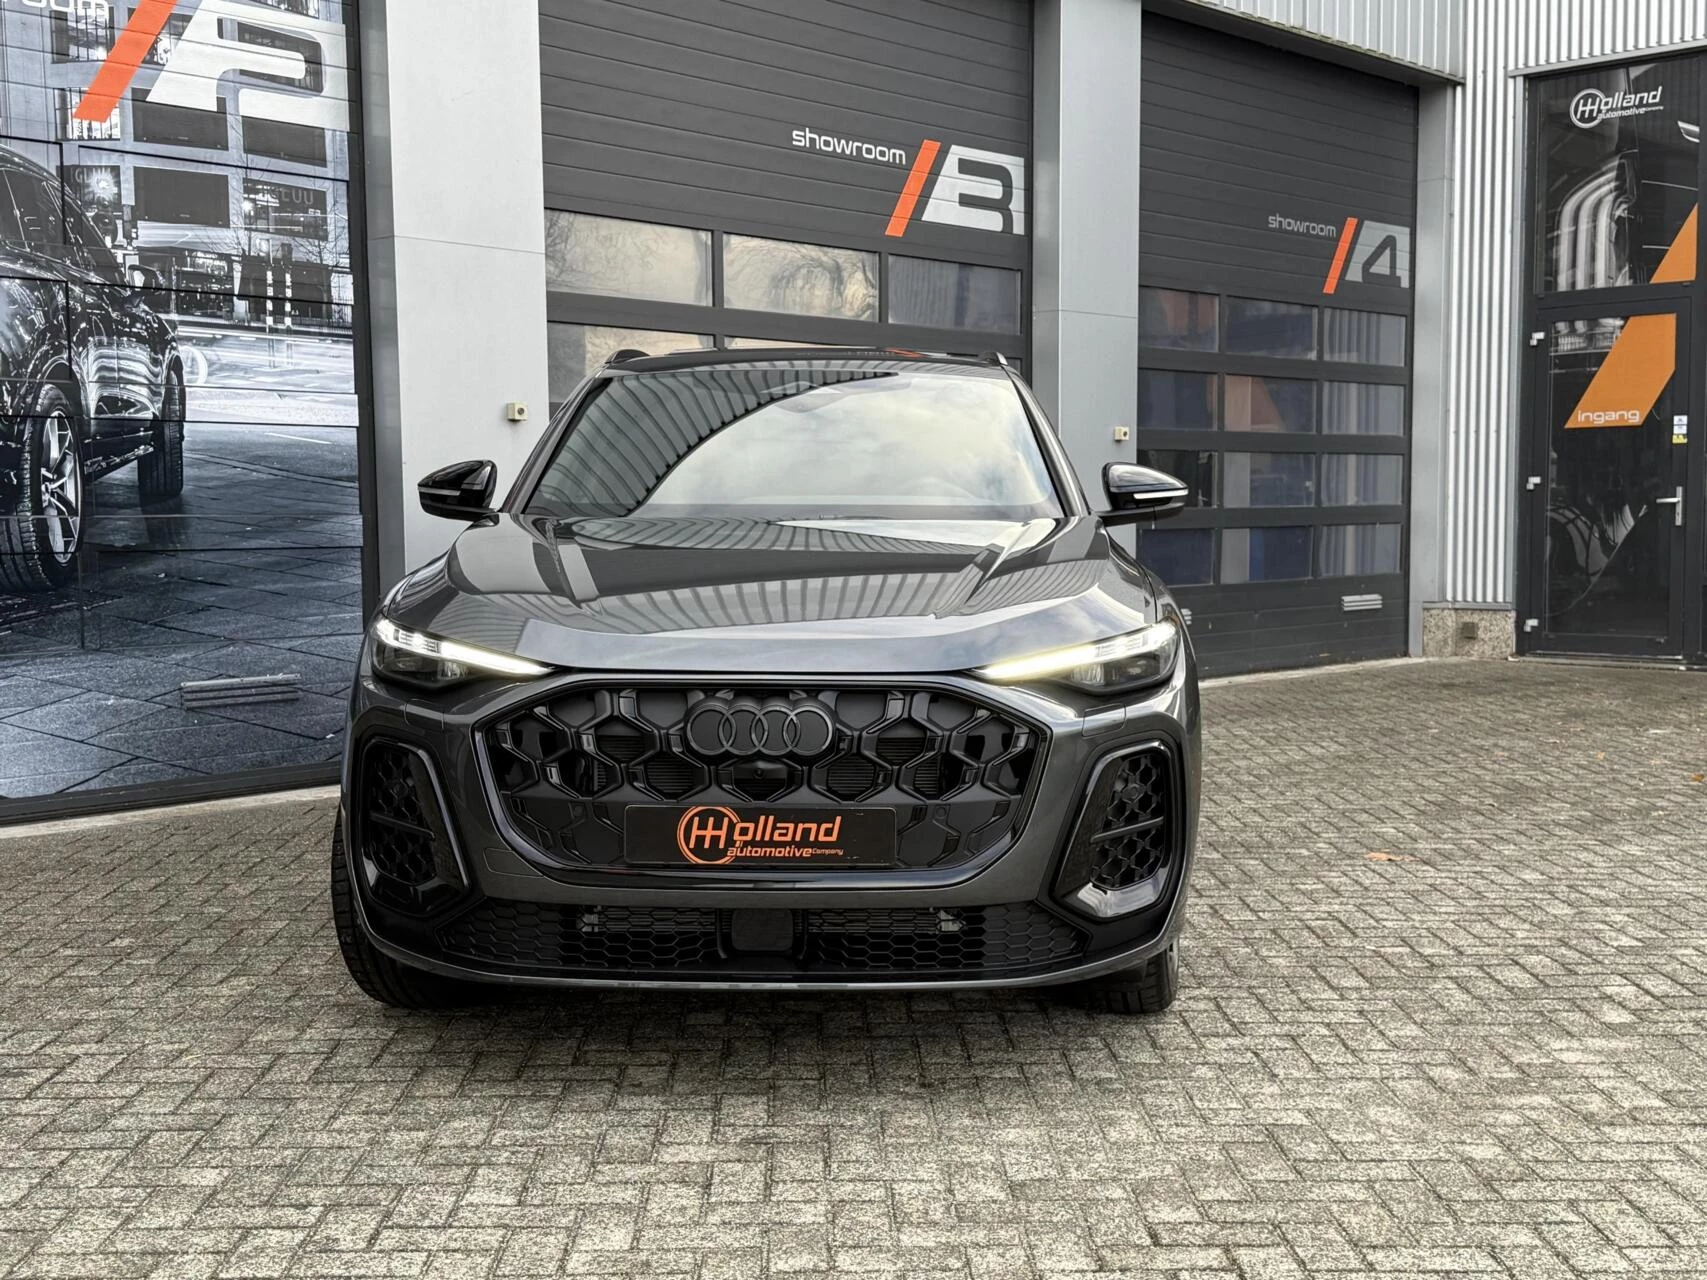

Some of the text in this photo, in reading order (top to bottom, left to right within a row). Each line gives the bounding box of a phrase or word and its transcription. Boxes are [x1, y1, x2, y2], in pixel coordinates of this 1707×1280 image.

[1598, 106, 1646, 119] automotive
[792, 128, 906, 164] showroom
[1268, 213, 1337, 238] showroom
[1578, 410, 1640, 424] ingang
[688, 815, 842, 849] Holland
[727, 845, 844, 857] automotive Company
